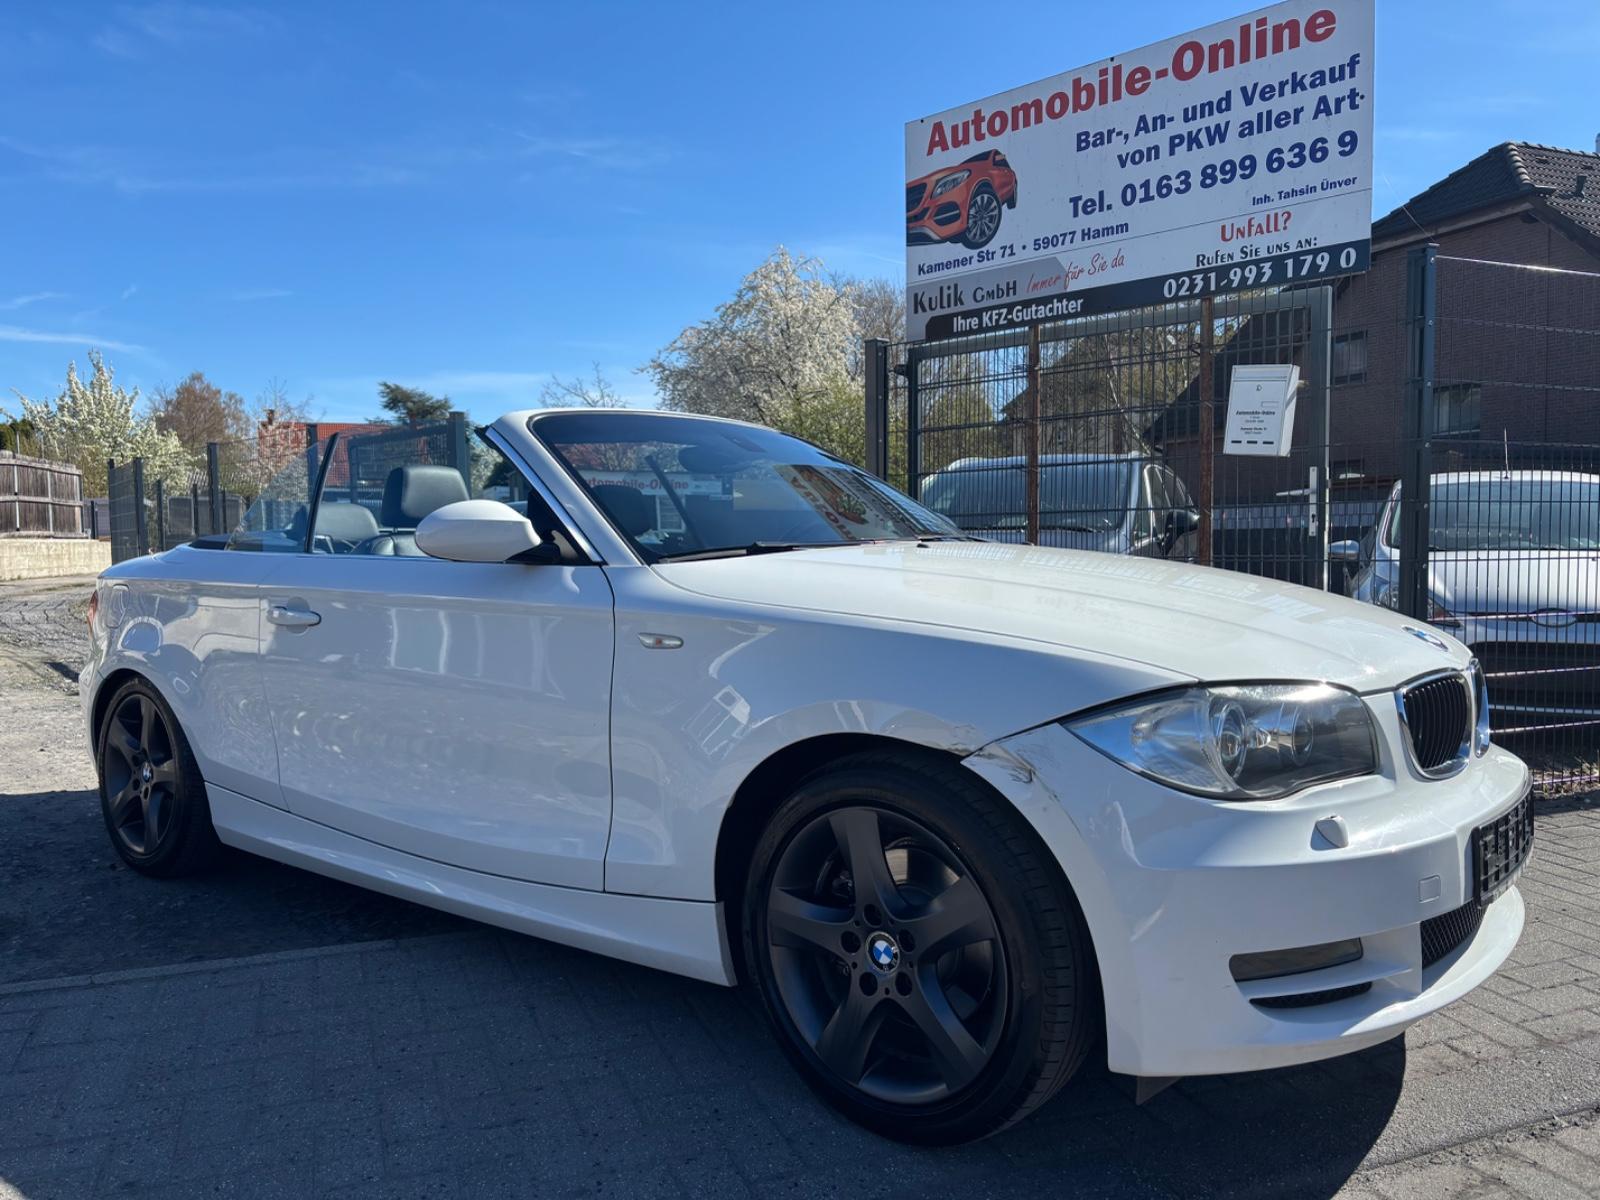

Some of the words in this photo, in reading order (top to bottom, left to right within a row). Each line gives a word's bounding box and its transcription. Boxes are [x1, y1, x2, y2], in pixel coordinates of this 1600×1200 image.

[926, 9, 1337, 157] Automobile-Online
[1134, 113, 1175, 138] An-
[1182, 90, 1232, 124] und
[1240, 53, 1361, 107] Verkauf
[1117, 142, 1160, 169] von
[1169, 120, 1231, 156] PKW
[1238, 106, 1304, 139] aller
[1069, 190, 1112, 218] Tel.
[1121, 169, 1192, 207] 0163
[1200, 154, 1257, 190] 899
[1265, 136, 1329, 173] 636
[1252, 194, 1274, 206] Inh.
[1277, 185, 1317, 201] Tahsin
[1320, 176, 1358, 191] Ünver
[918, 256, 974, 276] Kamener
[976, 249, 996, 264] Str
[1000, 245, 1016, 258] 71
[1033, 230, 1077, 251] 59077
[1080, 222, 1129, 242] Hamm
[1025, 273, 1062, 294] Immer
[1063, 262, 1085, 291] für
[1087, 252, 1108, 276] Sie
[1111, 248, 1125, 269] da
[913, 282, 965, 314] Kulik
[1163, 261, 1273, 298] 0231-993
[1284, 251, 1331, 279] 179
[953, 315, 979, 333] Ihre
[982, 298, 1083, 328] KFZ-Gutachter
